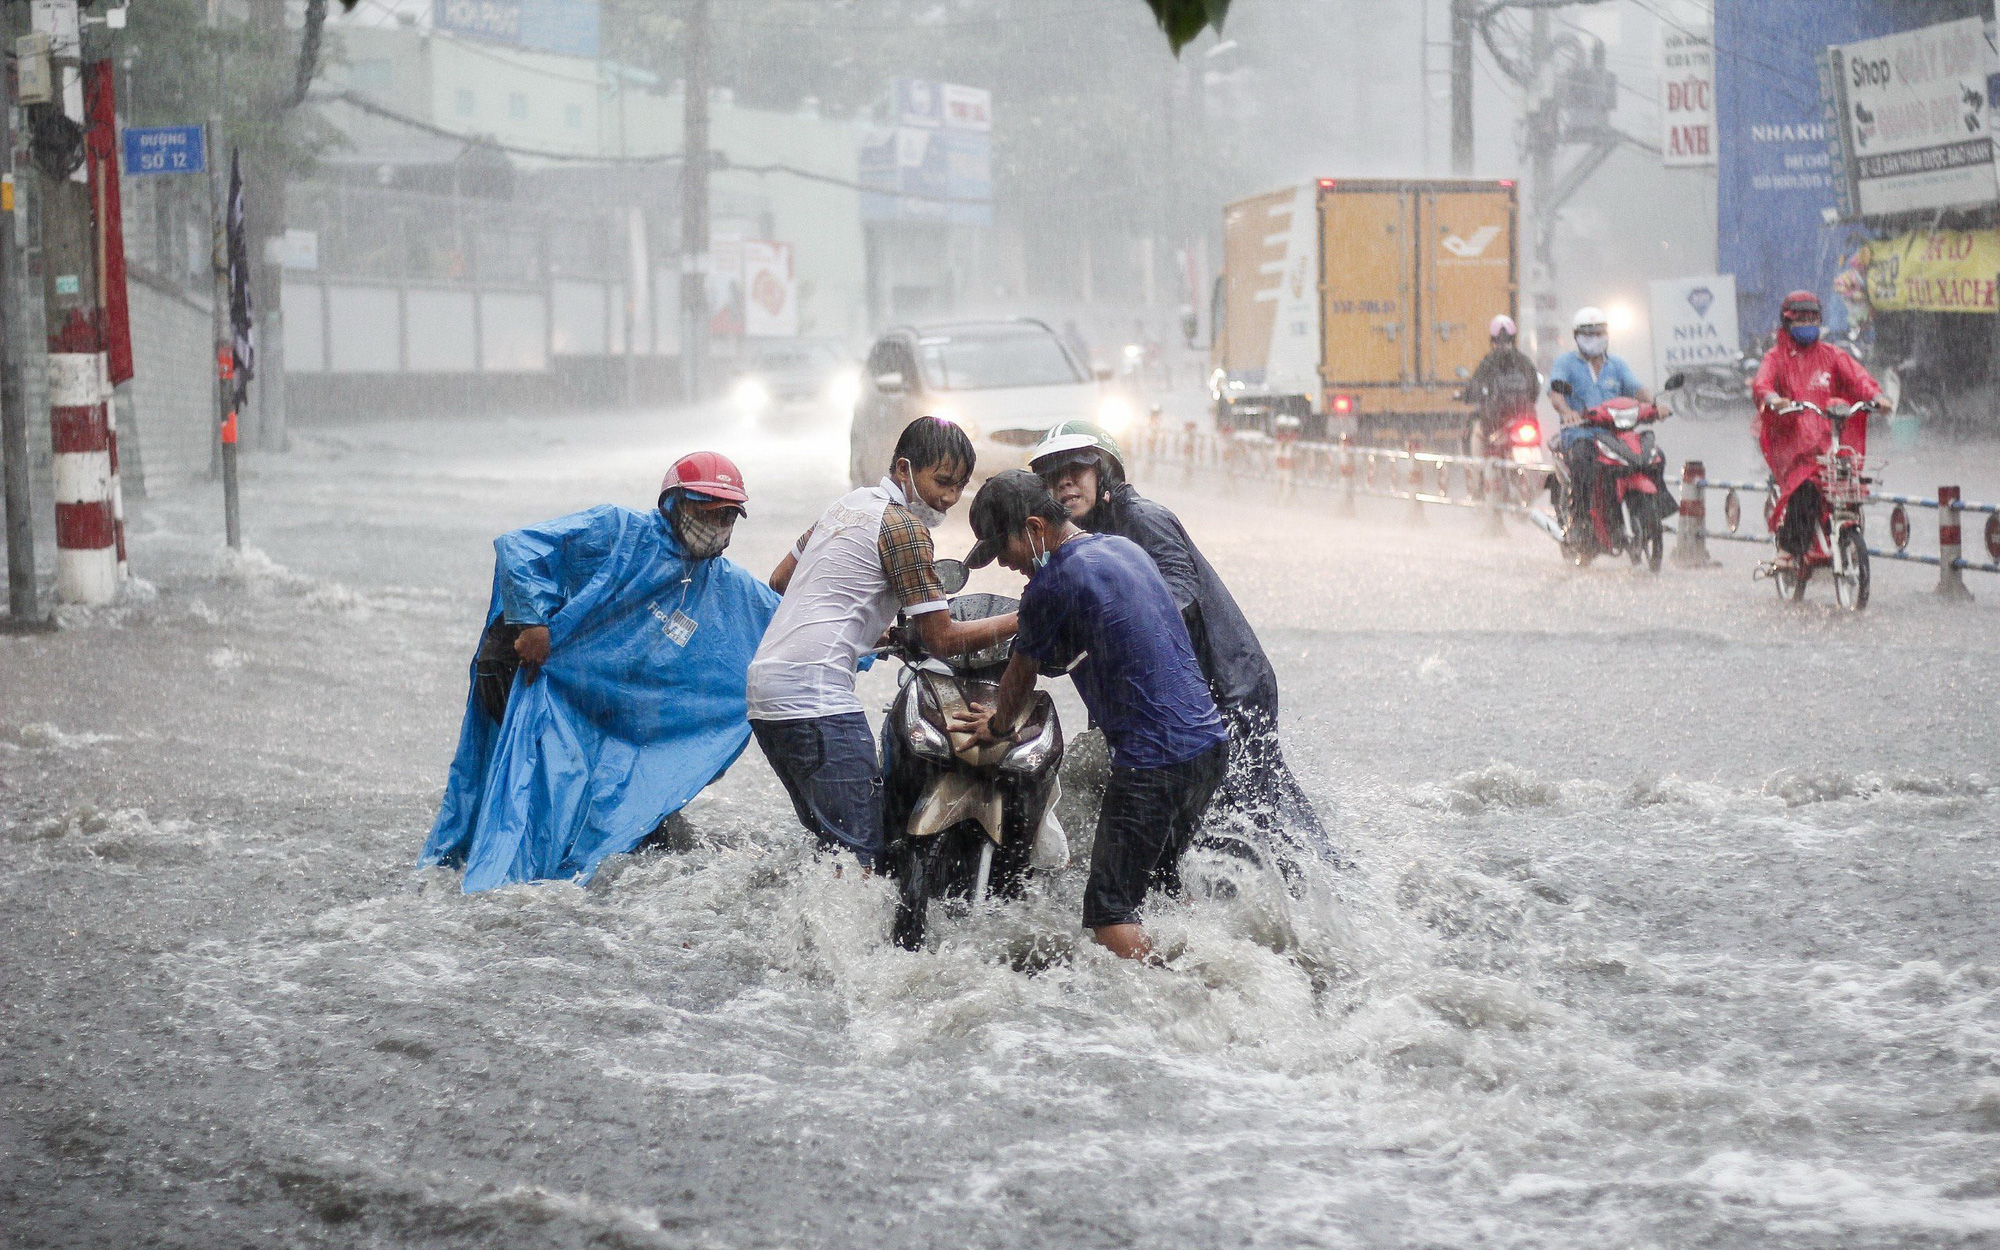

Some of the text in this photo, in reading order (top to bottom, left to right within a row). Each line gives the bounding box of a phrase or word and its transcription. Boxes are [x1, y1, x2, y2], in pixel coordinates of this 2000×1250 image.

[1851, 57, 1891, 91] Shop
[1669, 126, 1710, 155] ANH
[1751, 124, 1795, 141] NHA
[141, 146, 187, 169] SỐ 12
[1673, 323, 1717, 340] NHA
[1665, 344, 1728, 361] KHOA
